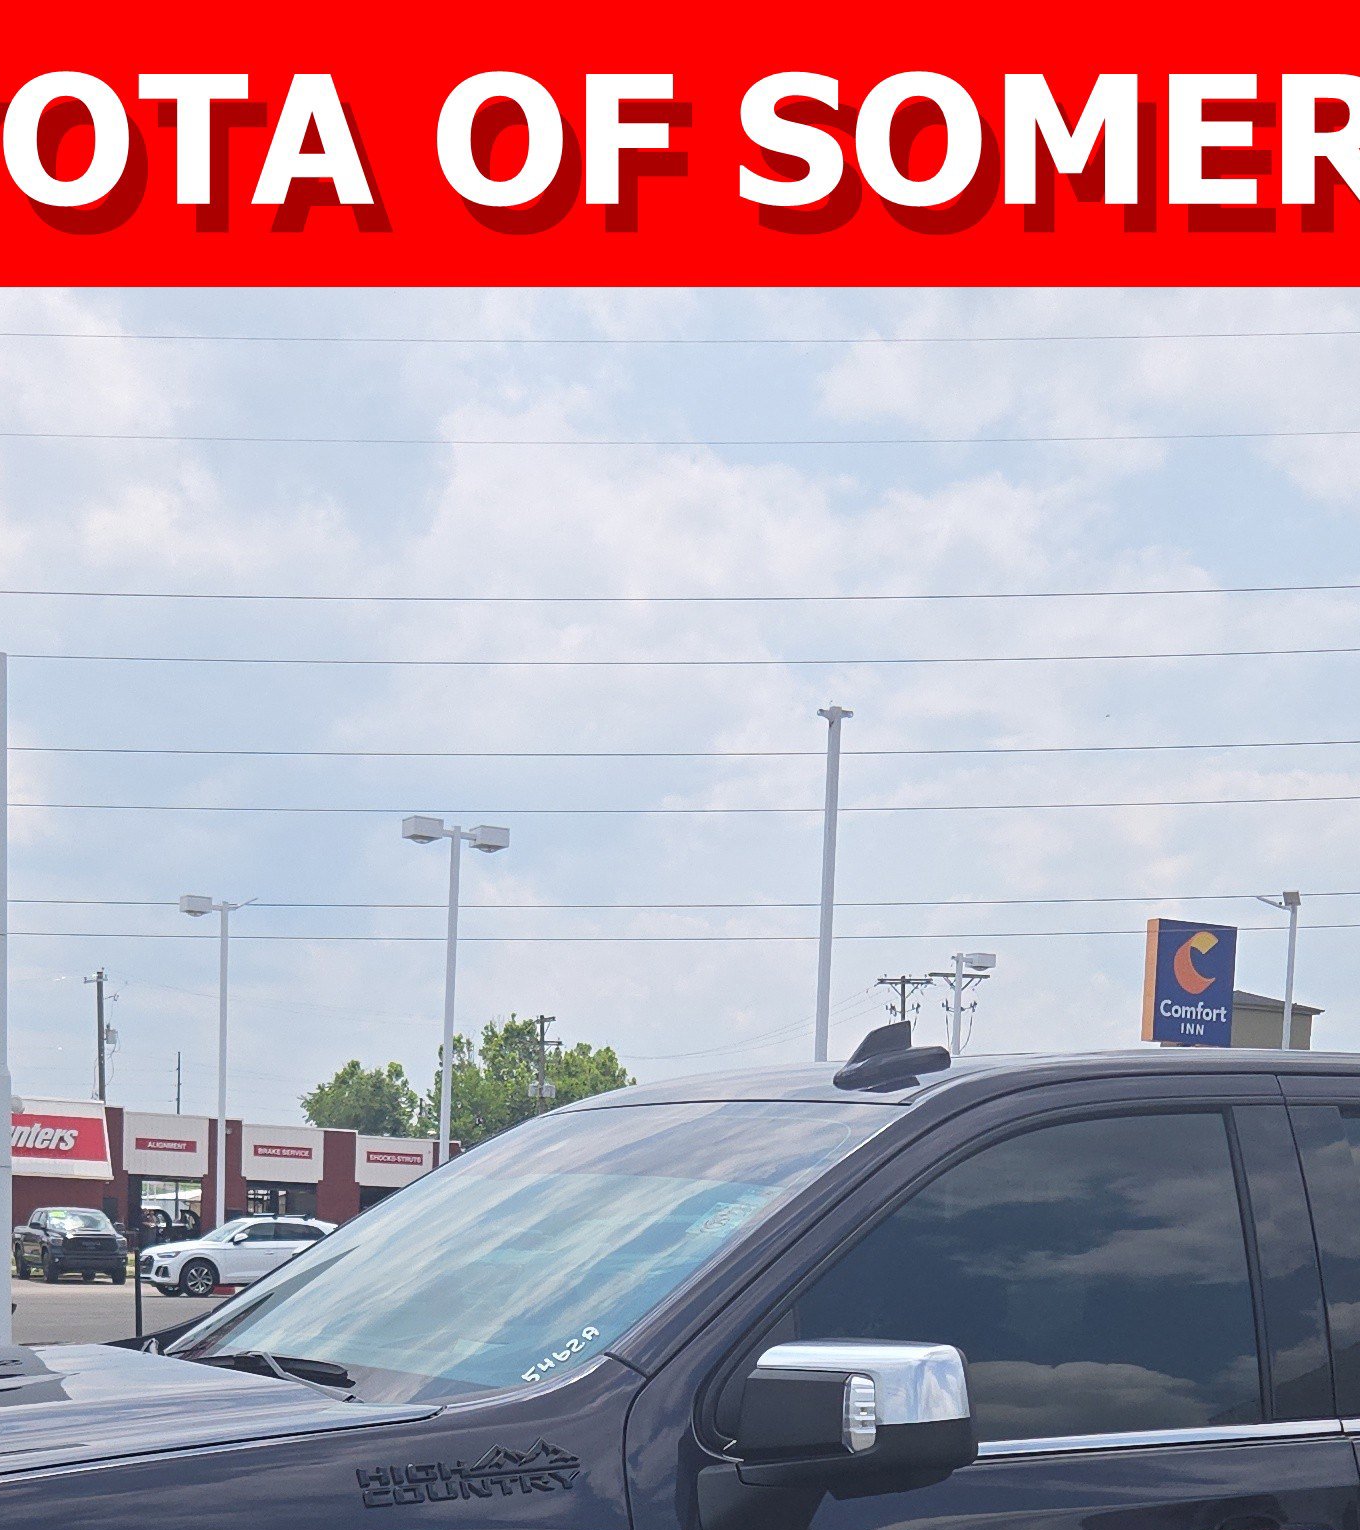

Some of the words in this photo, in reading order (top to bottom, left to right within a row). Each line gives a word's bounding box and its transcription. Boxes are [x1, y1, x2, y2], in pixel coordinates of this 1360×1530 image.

[1159, 999, 1228, 1023] Comfort
[1180, 1023, 1205, 1036] INN
[146, 1141, 188, 1150] ALIGNMENT
[257, 1147, 281, 1156] BRAKE
[281, 1148, 310, 1157] SERVICE
[521, 1325, 600, 1383] 5462A
[355, 1458, 470, 1489] HIGH
[362, 1469, 582, 1509] COUNTRY
